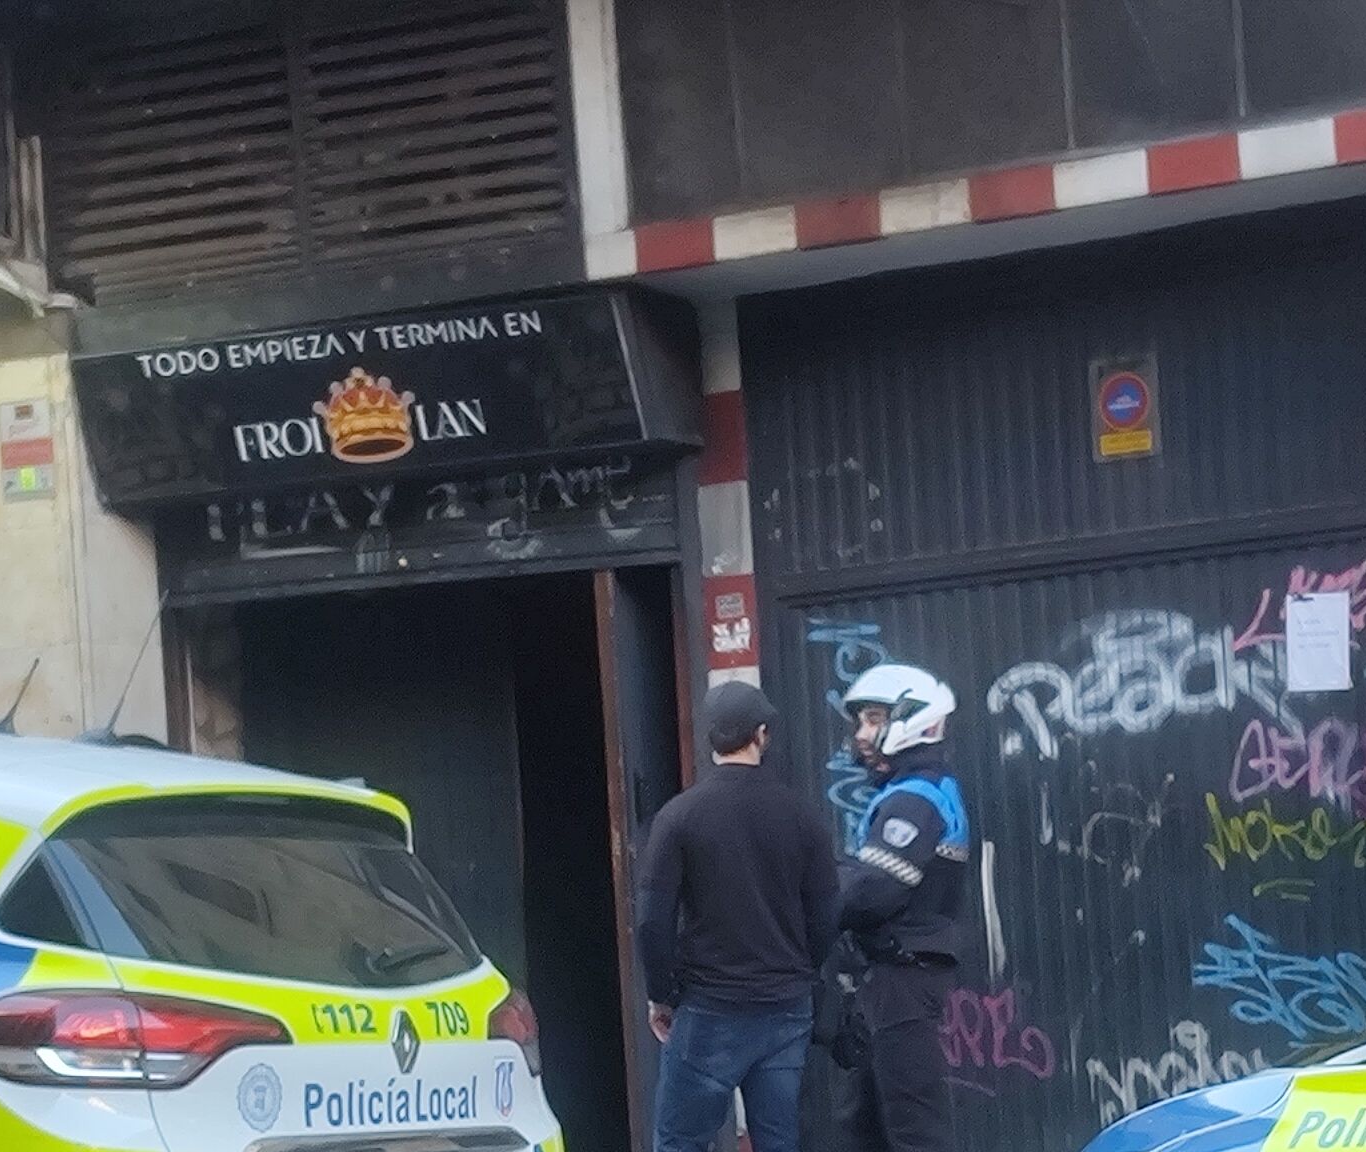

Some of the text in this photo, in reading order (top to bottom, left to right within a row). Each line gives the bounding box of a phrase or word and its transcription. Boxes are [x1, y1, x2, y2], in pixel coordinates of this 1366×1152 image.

[136, 309, 544, 381] TODO EMPIEZA Y TERMINA EN
[234, 399, 489, 464] FROI LAN
[321, 1003, 377, 1034] 112
[425, 1000, 470, 1036] 709
[304, 1077, 411, 1128] Policía
[416, 1075, 477, 1123] Local
